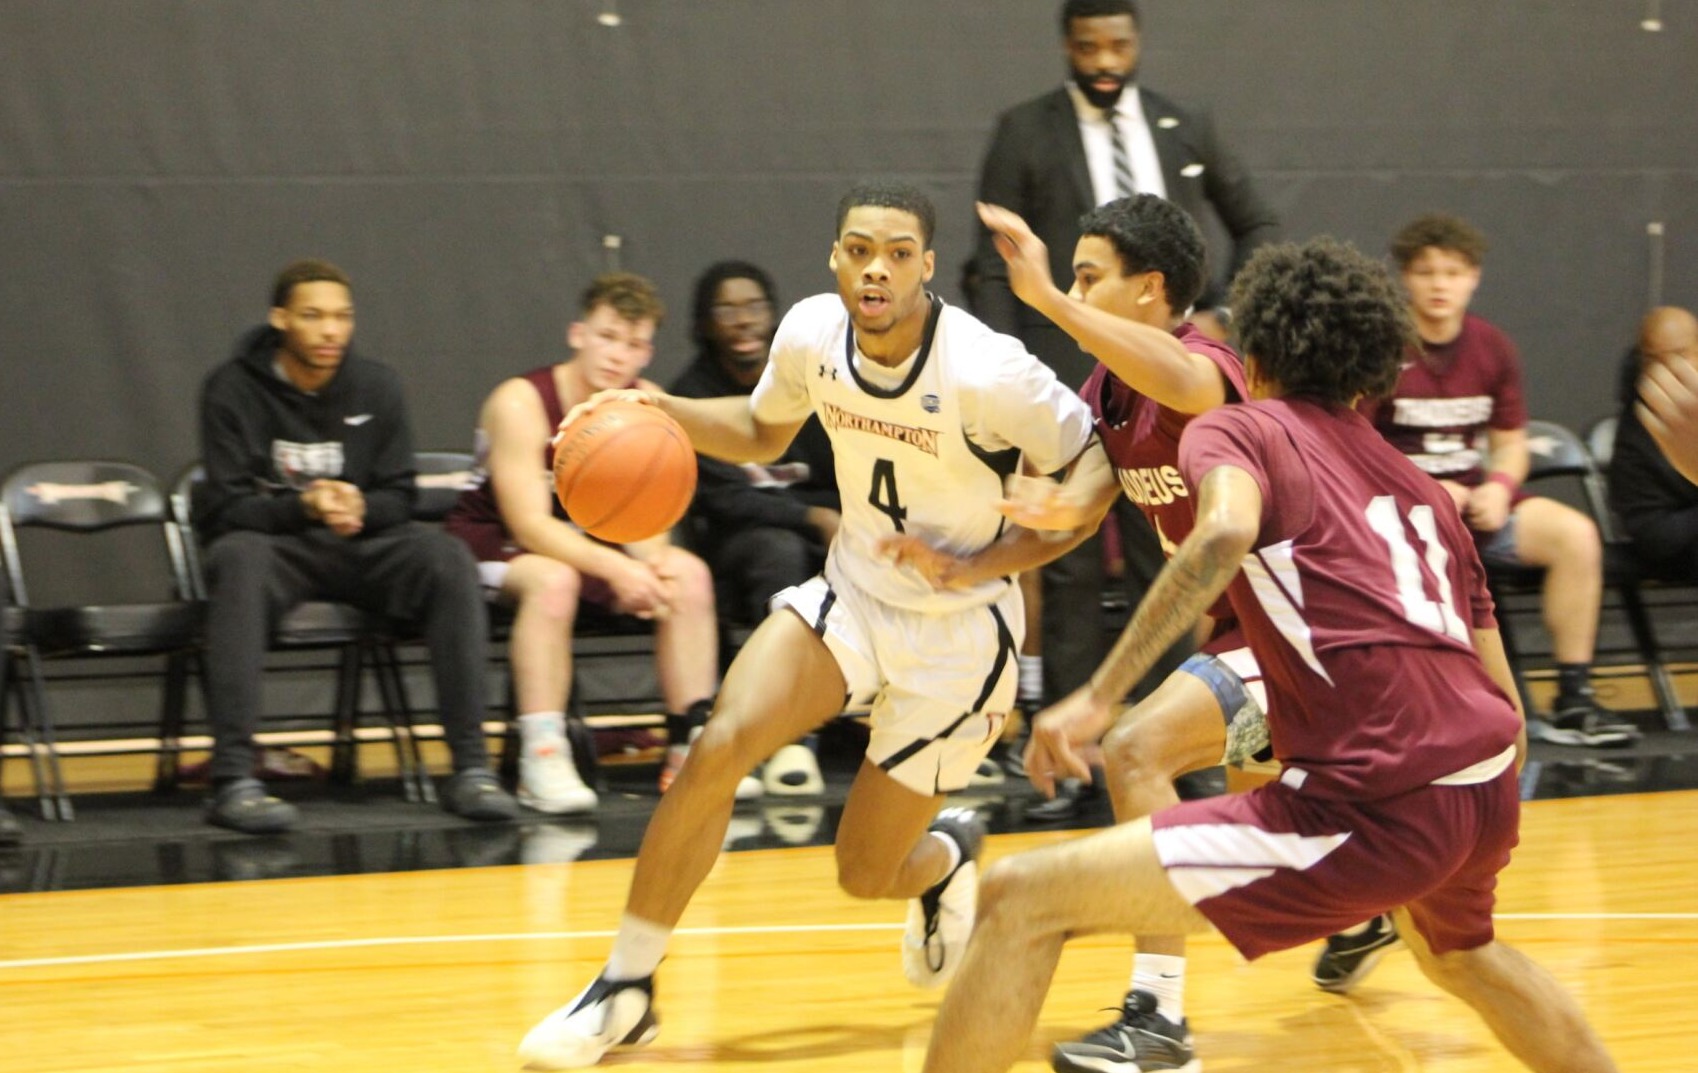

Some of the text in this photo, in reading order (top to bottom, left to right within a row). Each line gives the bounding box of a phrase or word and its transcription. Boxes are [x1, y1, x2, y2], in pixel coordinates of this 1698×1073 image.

[822, 401, 944, 460] NORTHAMPTON
[868, 457, 907, 534] 4
[1117, 464, 1189, 506] DDEUS
[1364, 494, 1472, 649] 11
